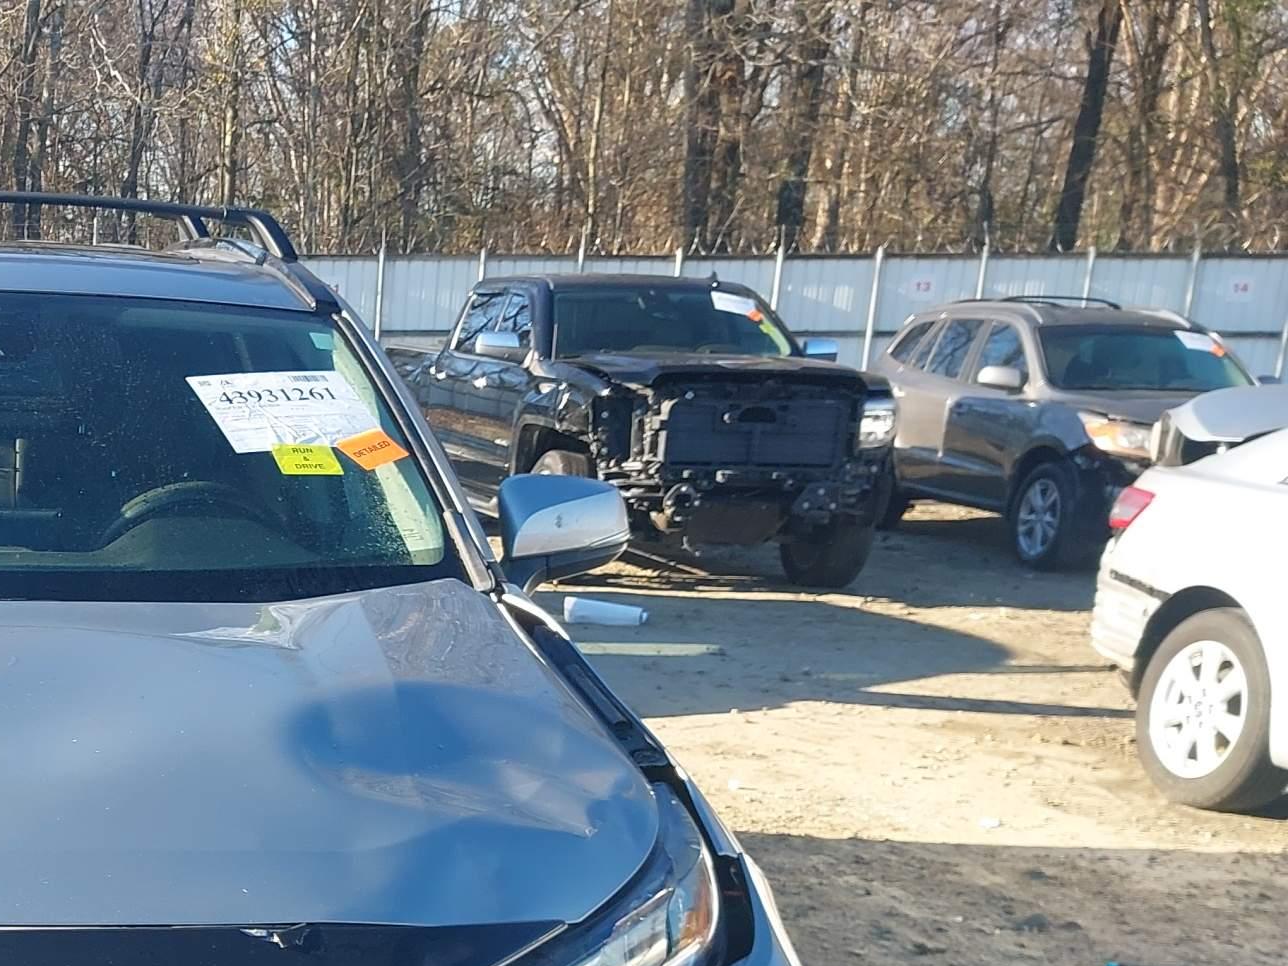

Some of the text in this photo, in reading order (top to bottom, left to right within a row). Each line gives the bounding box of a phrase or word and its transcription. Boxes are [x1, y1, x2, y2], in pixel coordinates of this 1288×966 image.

[219, 387, 337, 405] 43931261
[292, 447, 314, 455] RUN
[353, 440, 391, 458] DETAILED
[294, 463, 327, 471] DRIVE
